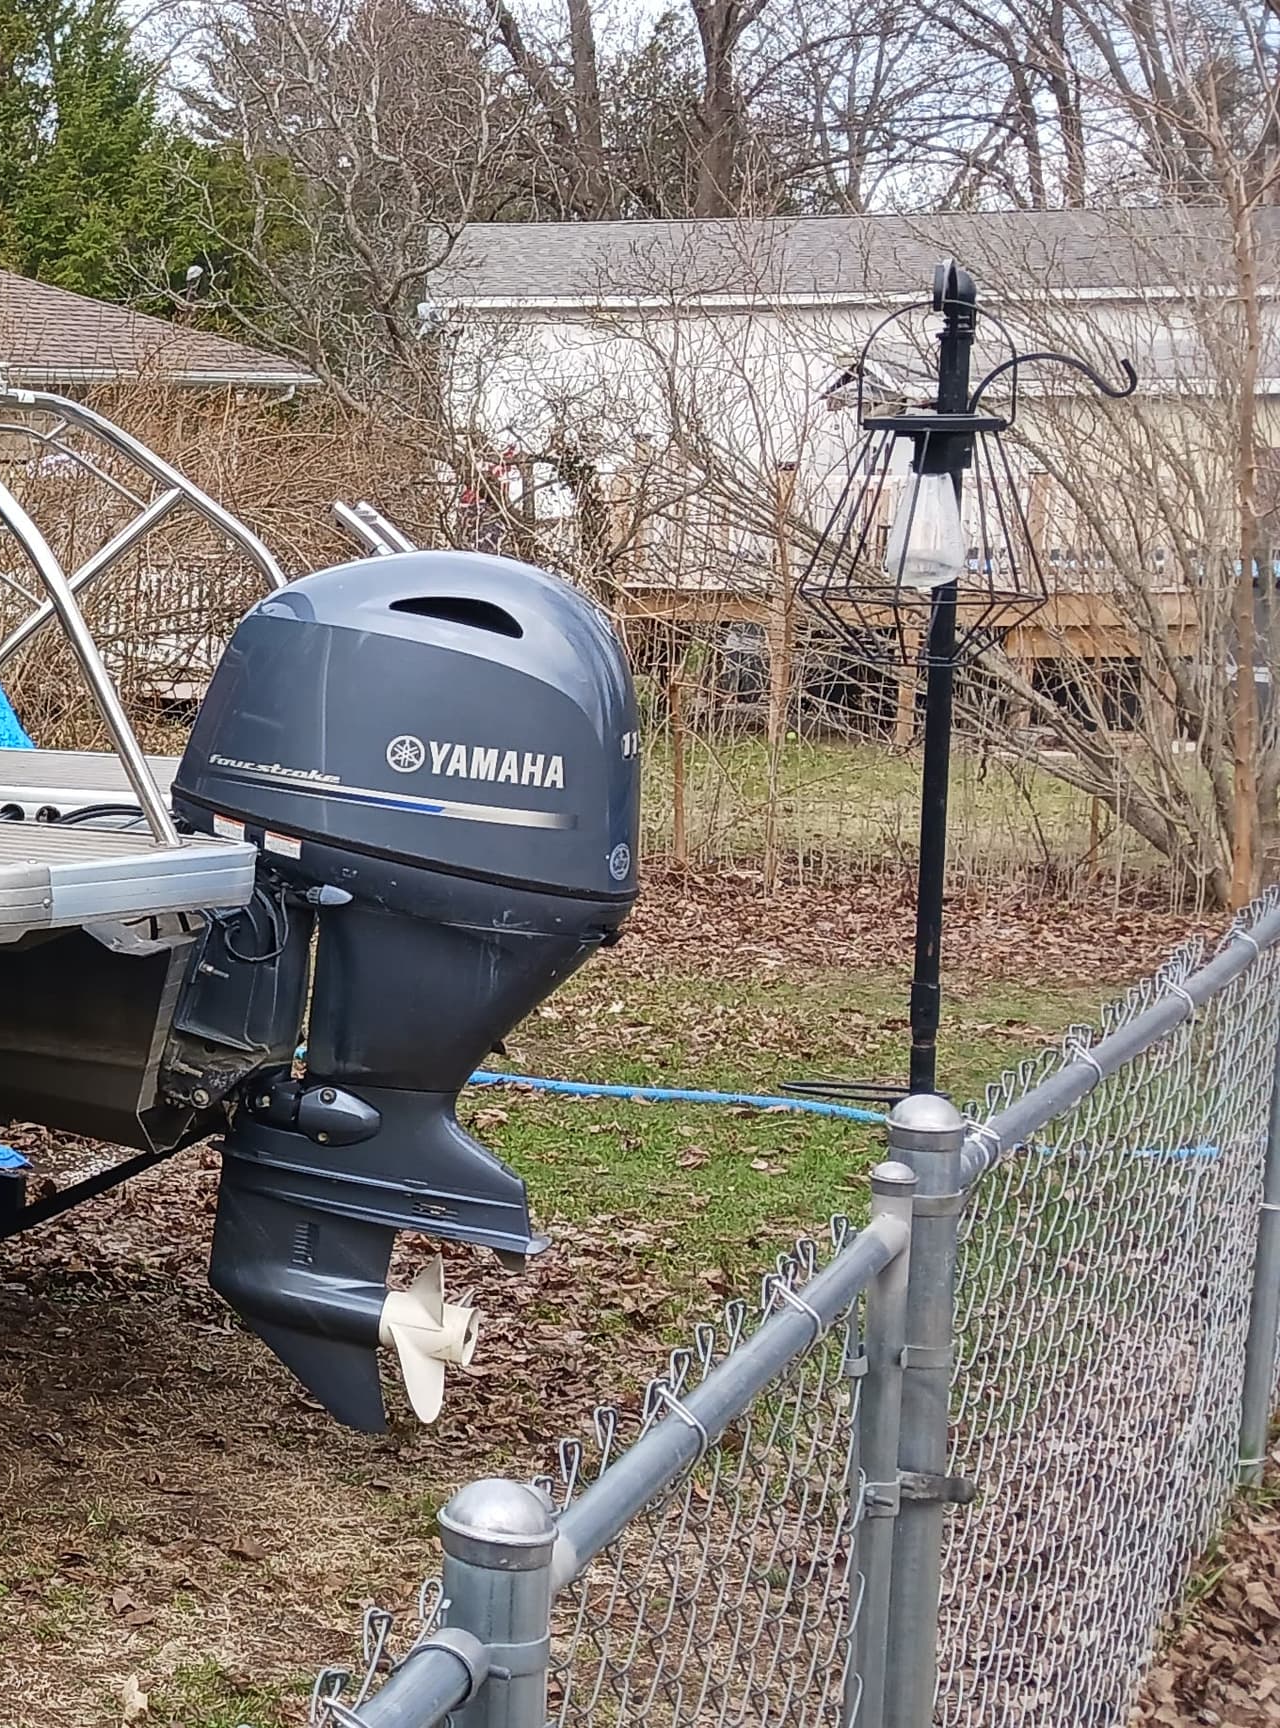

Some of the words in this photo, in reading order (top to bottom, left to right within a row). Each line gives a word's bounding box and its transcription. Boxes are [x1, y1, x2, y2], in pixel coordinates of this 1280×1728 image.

[622, 731, 641, 757] 11
[209, 754, 341, 784] fourstroke
[429, 741, 565, 789] YAMAHA
